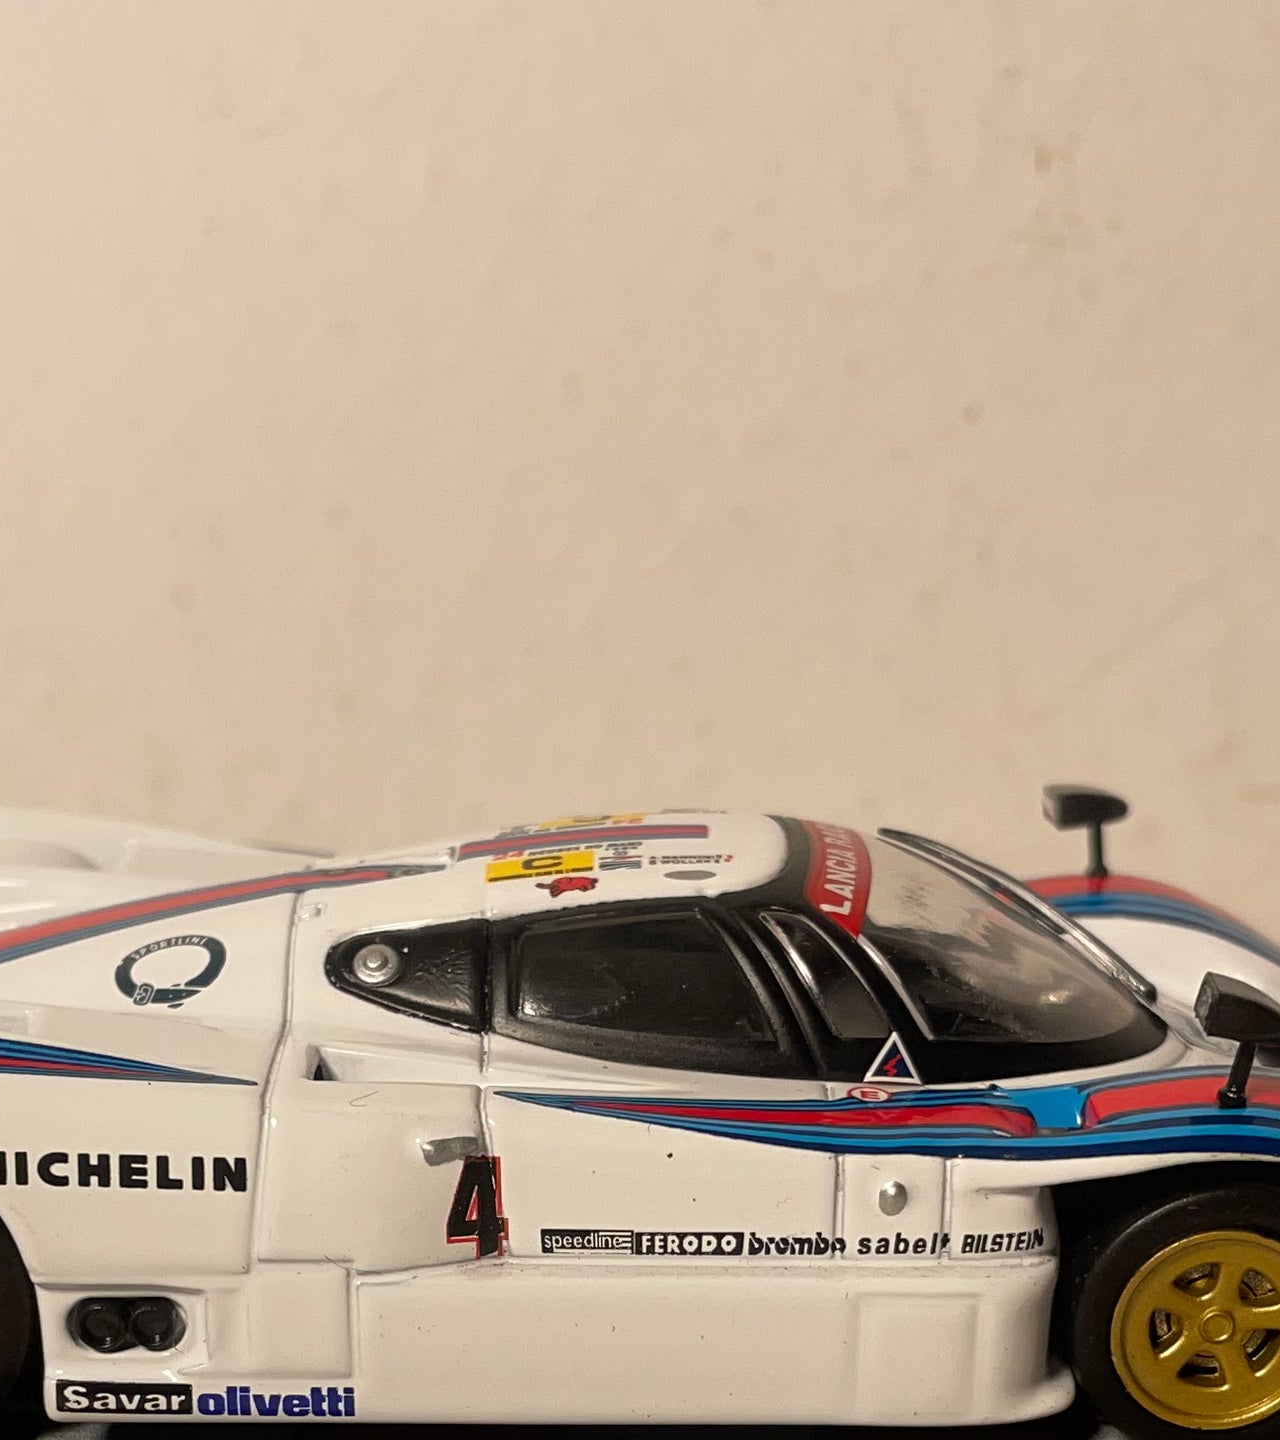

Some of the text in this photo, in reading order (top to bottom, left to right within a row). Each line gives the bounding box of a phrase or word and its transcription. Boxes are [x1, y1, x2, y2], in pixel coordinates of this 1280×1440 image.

[819, 848, 858, 916] LANCIA
[446, 1154, 510, 1260] 4
[543, 1232, 625, 1250] speedline
[641, 1234, 738, 1254] FERODO
[748, 1231, 847, 1256] brembo
[856, 1231, 951, 1256] sabelt
[960, 1227, 1045, 1255] BILSTEIN
[61, 1384, 188, 1411] Savar
[197, 1386, 357, 1417] olivetti
